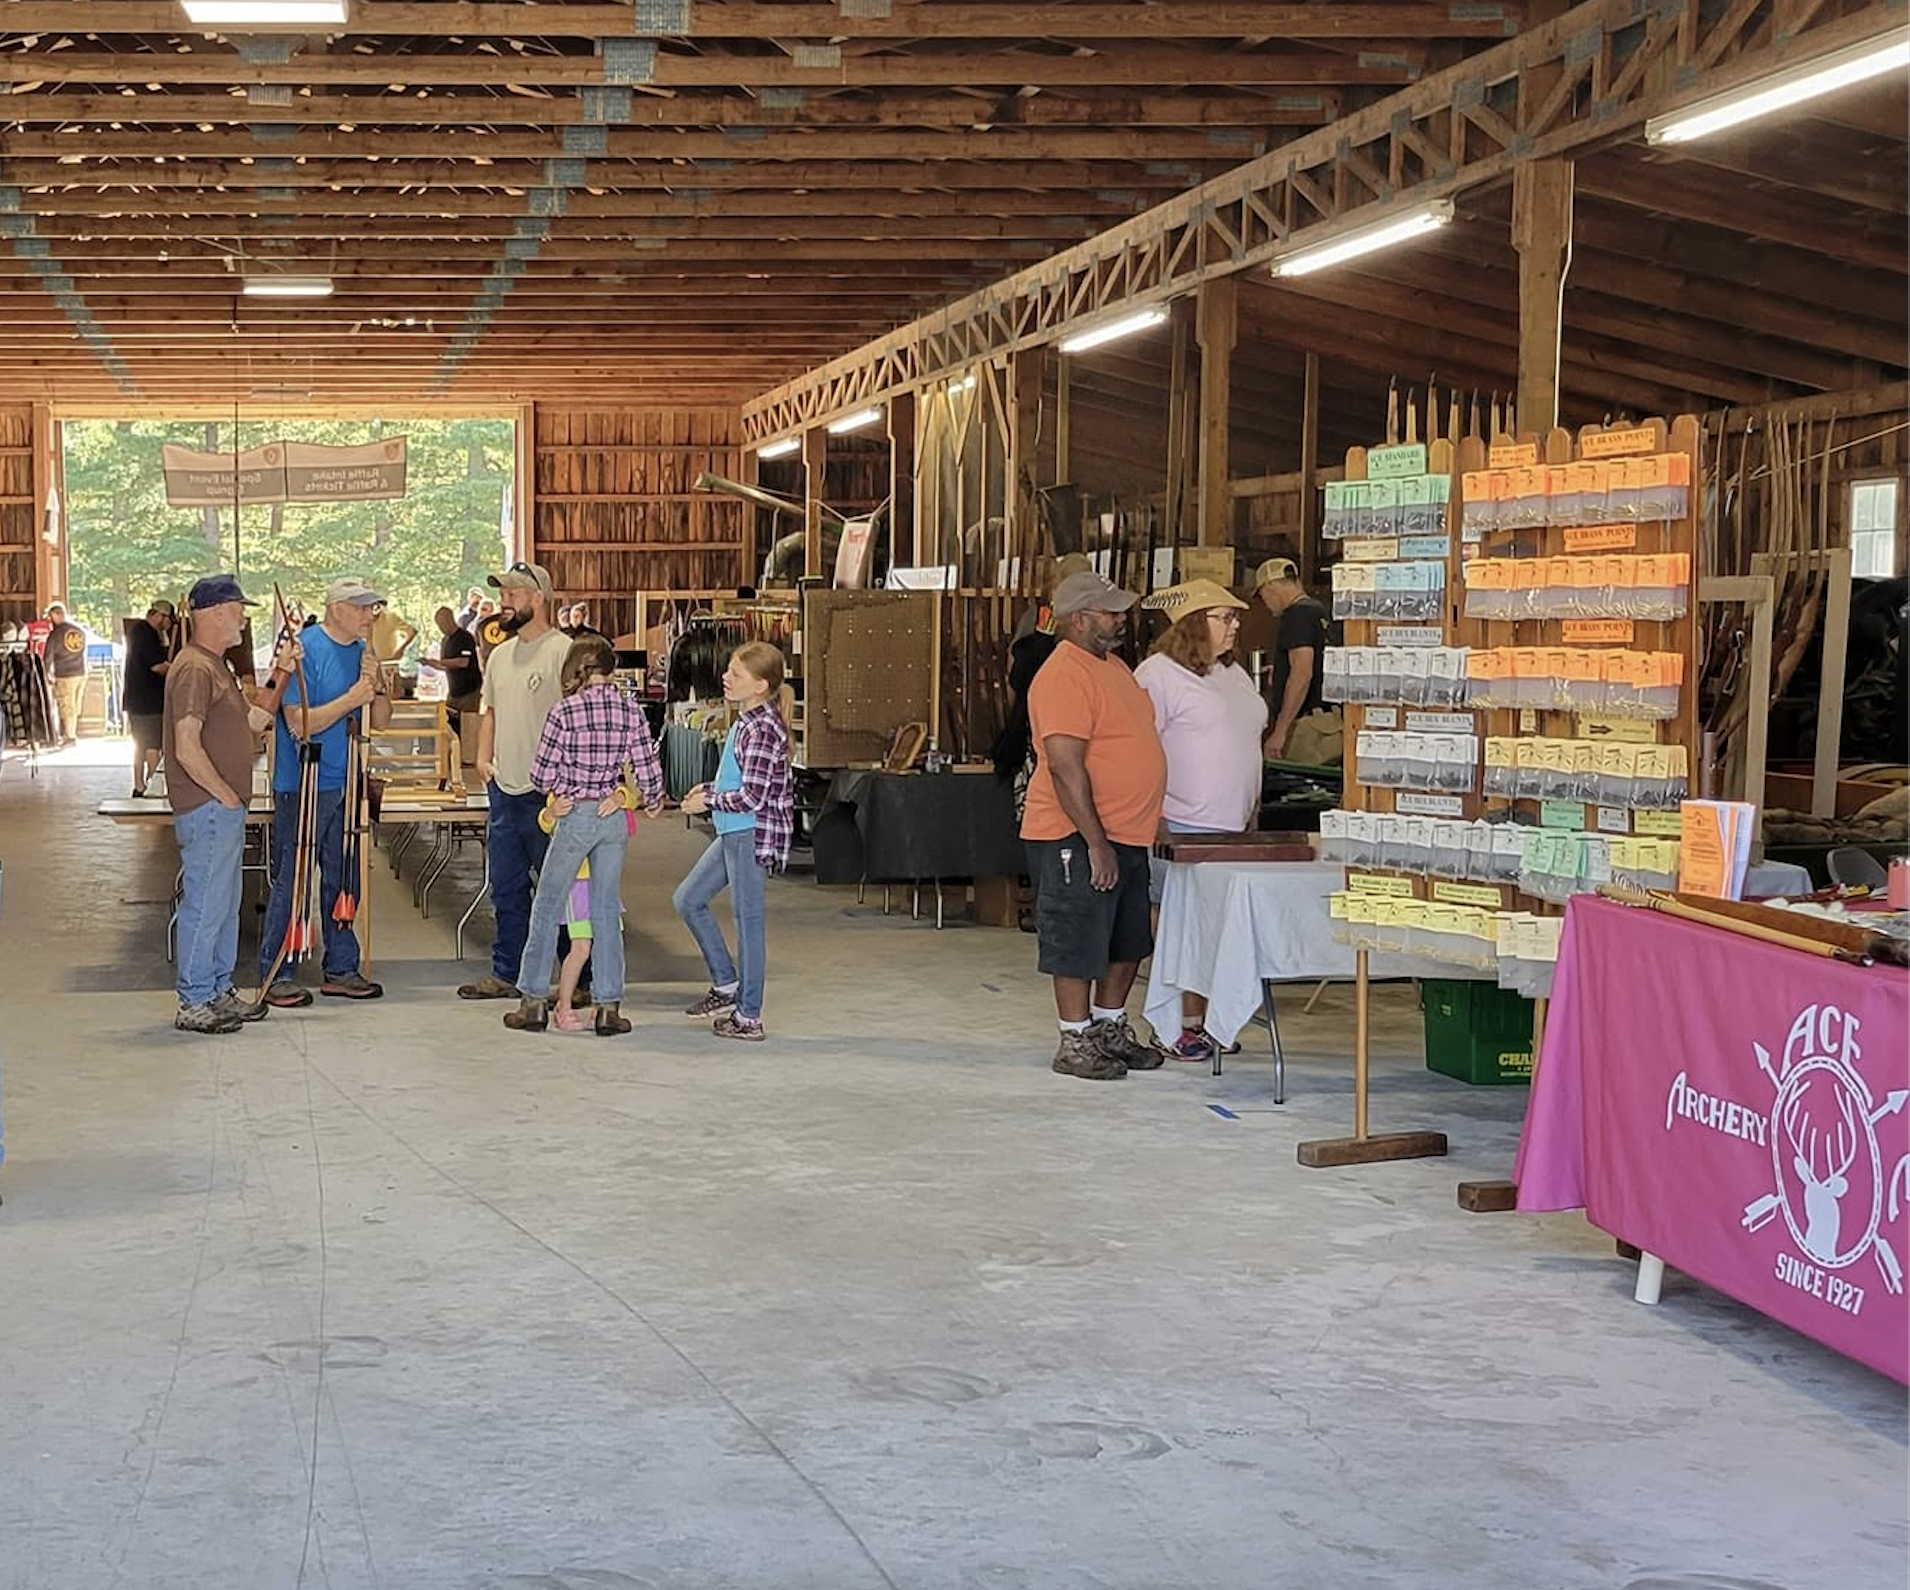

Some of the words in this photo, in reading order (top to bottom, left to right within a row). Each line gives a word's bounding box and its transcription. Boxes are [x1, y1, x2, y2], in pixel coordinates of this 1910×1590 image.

[1597, 434, 1622, 446] BRASS
[1624, 431, 1654, 442] POINTS
[1384, 449, 1421, 461] STANDARD
[1580, 530, 1603, 539] BRASS
[1579, 623, 1601, 631] BRASS
[1781, 1003, 1874, 1109] ACE
[1666, 1071, 1769, 1147] ARCHERY
[1774, 1252, 1825, 1294] SINCE
[1826, 1274, 1866, 1317] 1927
